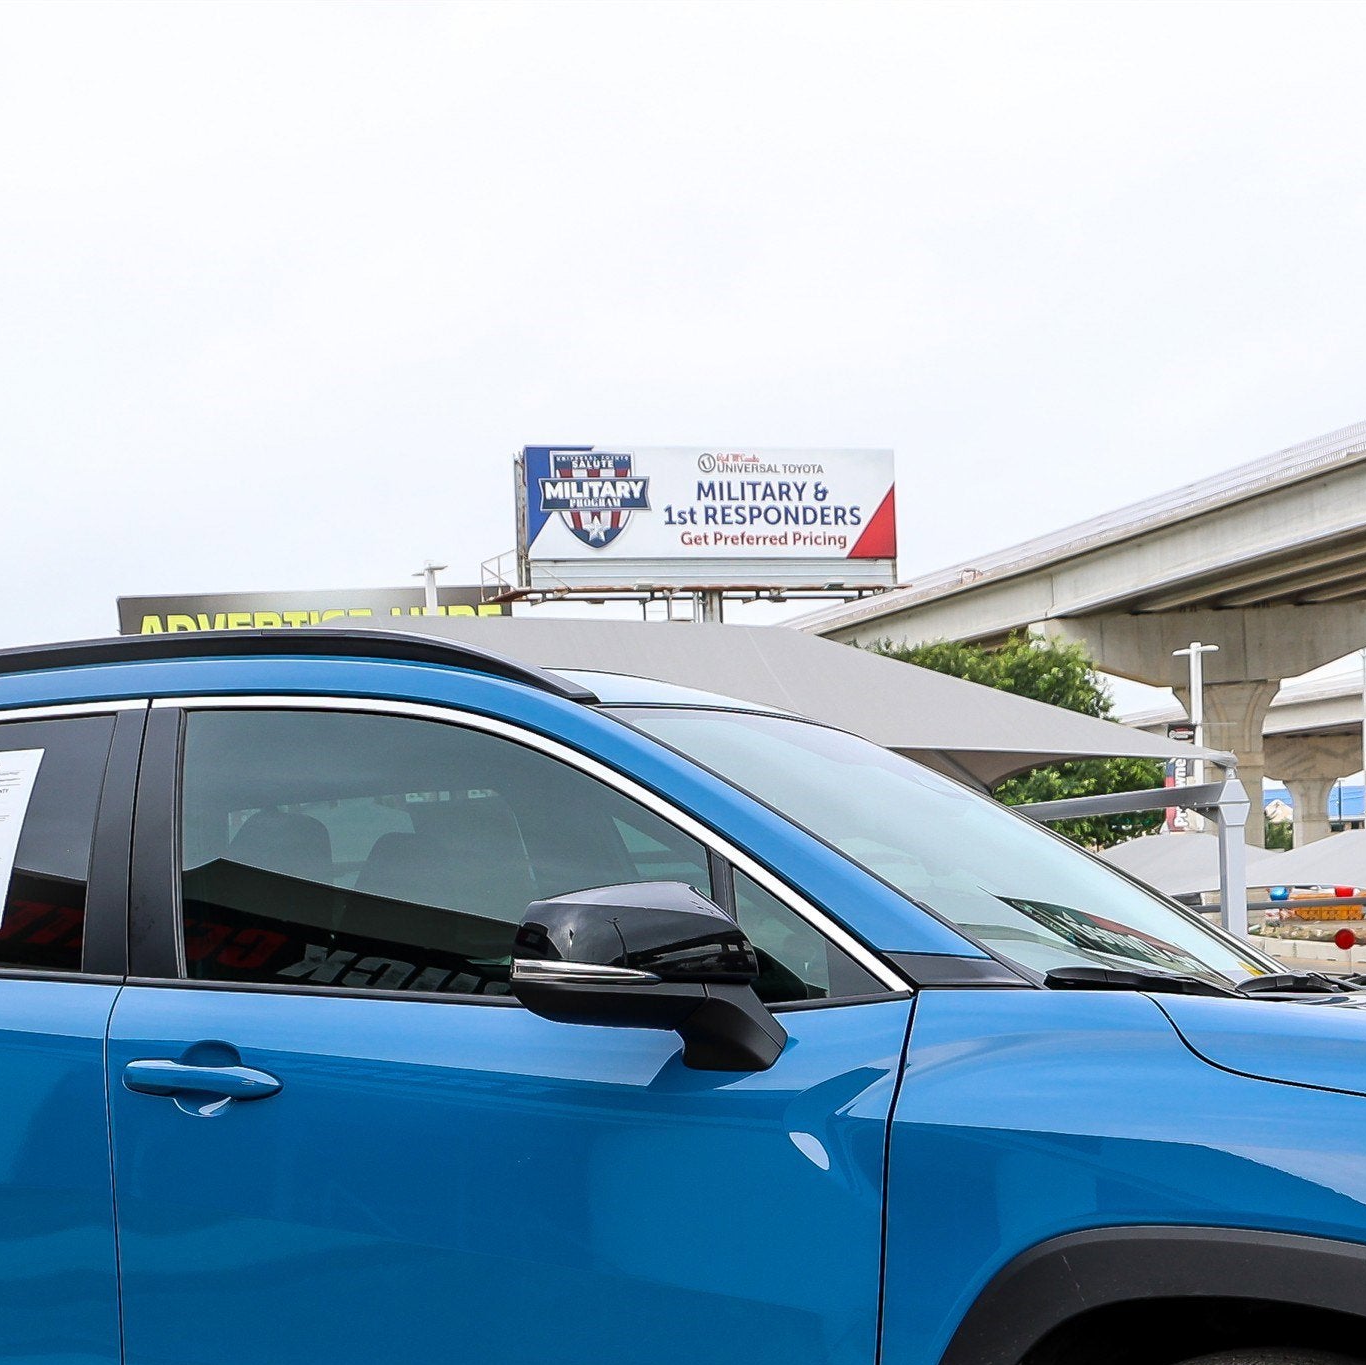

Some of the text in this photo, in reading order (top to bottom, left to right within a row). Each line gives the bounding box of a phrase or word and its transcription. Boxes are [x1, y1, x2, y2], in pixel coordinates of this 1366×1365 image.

[571, 460, 614, 468] SALUTE
[717, 463, 824, 474] UNIVERSAL TOYOTA
[544, 481, 644, 500] MILITARY
[696, 480, 829, 501] MILITARY &
[569, 498, 621, 508] PROGRAM
[663, 504, 862, 526] 1st RESPONDERS
[680, 531, 847, 549] Get Preferred Pricing
